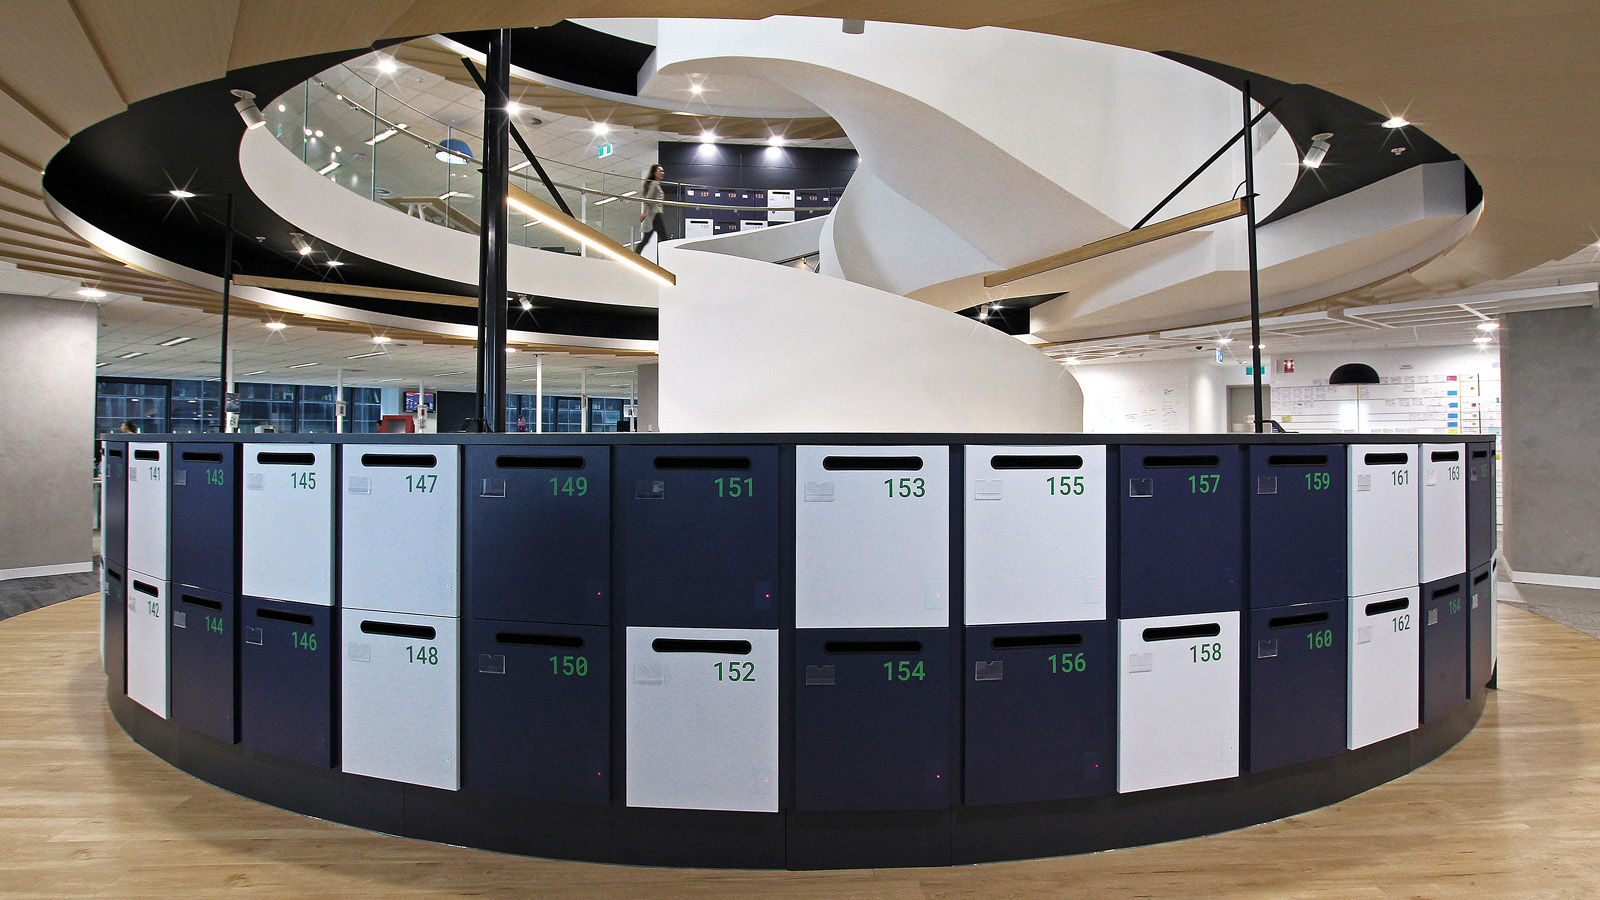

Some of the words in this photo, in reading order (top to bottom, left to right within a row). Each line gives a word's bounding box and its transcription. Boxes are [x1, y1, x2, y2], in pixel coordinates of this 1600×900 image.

[149, 466, 161, 481] 141
[206, 469, 224, 486] 143
[290, 471, 317, 491] 145
[405, 474, 437, 493] 147
[1304, 472, 1331, 491] 159
[1391, 469, 1410, 487] 161
[1448, 466, 1461, 481] 163
[549, 476, 588, 497] 149
[714, 477, 753, 498] 151
[885, 478, 926, 498] 153
[1047, 476, 1085, 495] 155
[1188, 474, 1221, 494] 157
[148, 601, 160, 618] 142
[1449, 599, 1461, 615] 164
[205, 616, 224, 635] 144
[1394, 614, 1412, 632] 162
[291, 630, 319, 652] 146
[1307, 629, 1333, 650] 160
[405, 646, 438, 666] 148
[1048, 652, 1087, 674] 156
[1191, 643, 1222, 663] 158
[549, 655, 588, 677] 150
[714, 662, 755, 683] 152
[883, 660, 926, 681] 154
